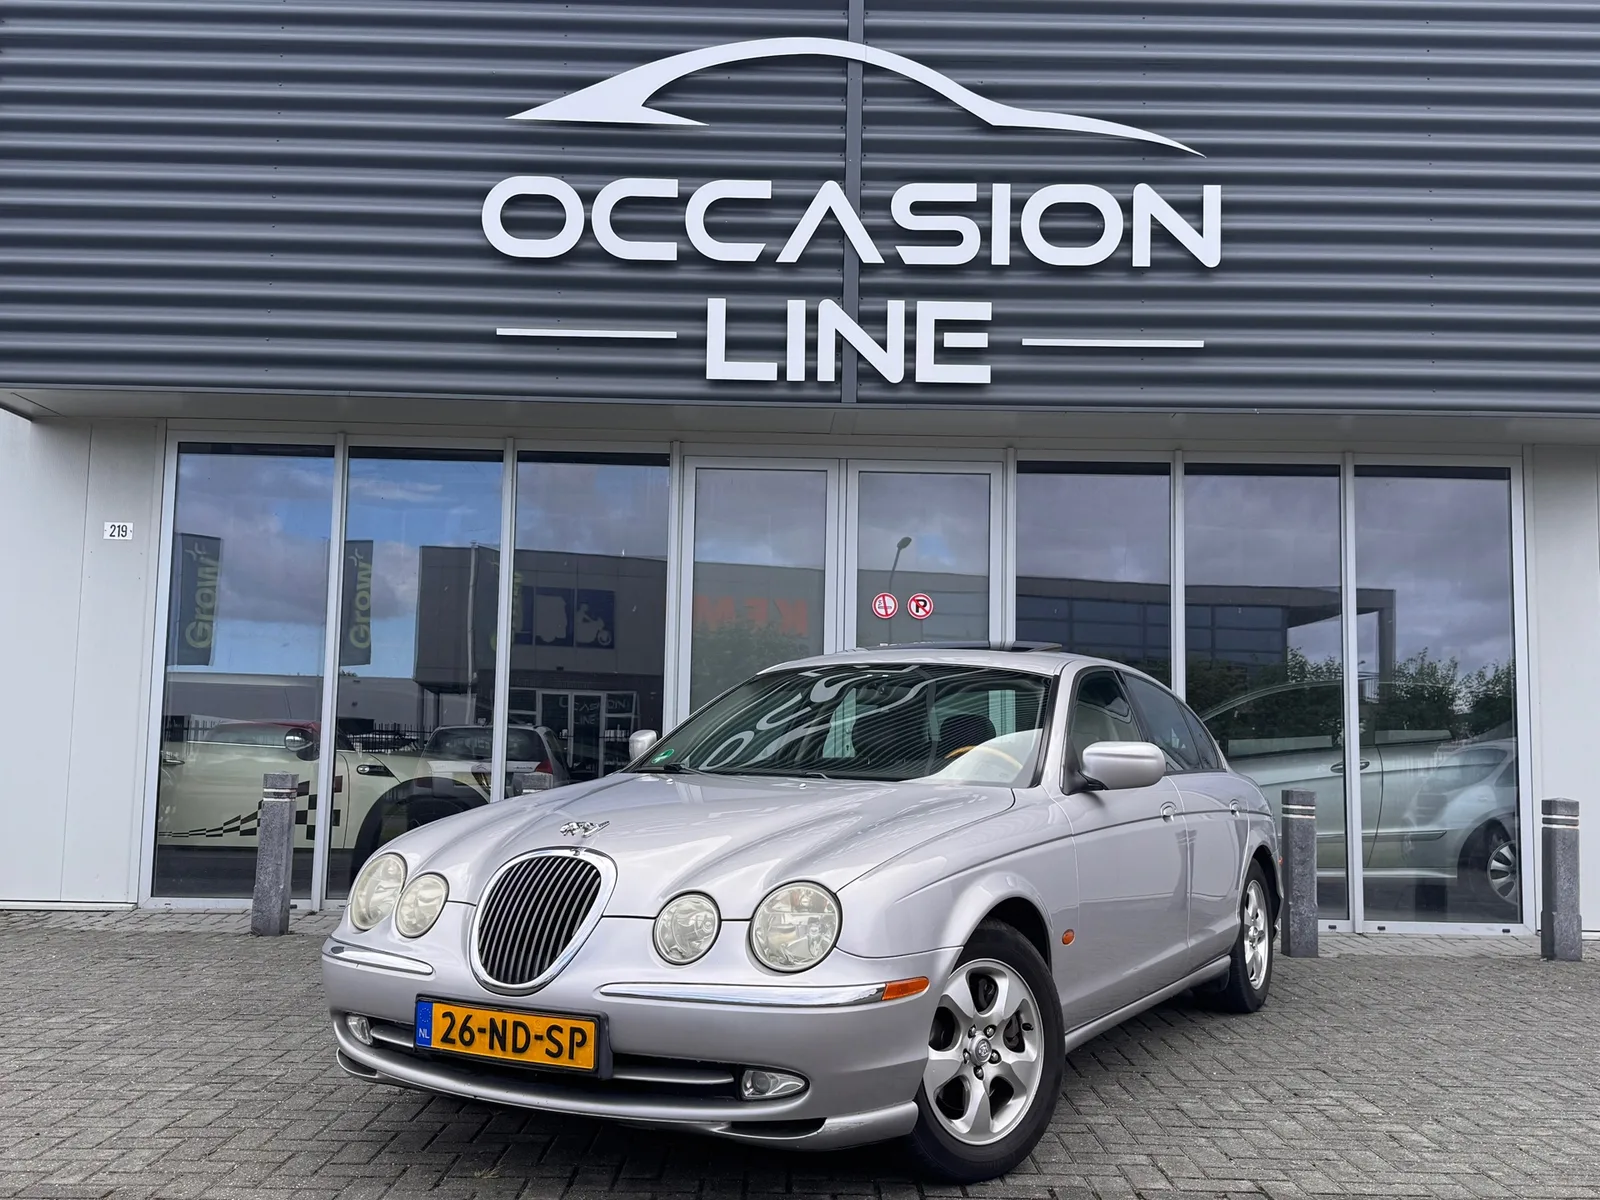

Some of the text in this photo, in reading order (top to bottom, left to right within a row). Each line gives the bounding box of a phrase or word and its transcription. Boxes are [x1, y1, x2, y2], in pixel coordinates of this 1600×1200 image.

[481, 175, 1221, 268] OCCASION
[706, 298, 992, 384] LINE
[109, 524, 128, 537] 219
[185, 557, 219, 648] Grow
[349, 562, 372, 649] Grow
[418, 1028, 431, 1040] NL
[440, 1011, 588, 1060] 26-ND-SP
